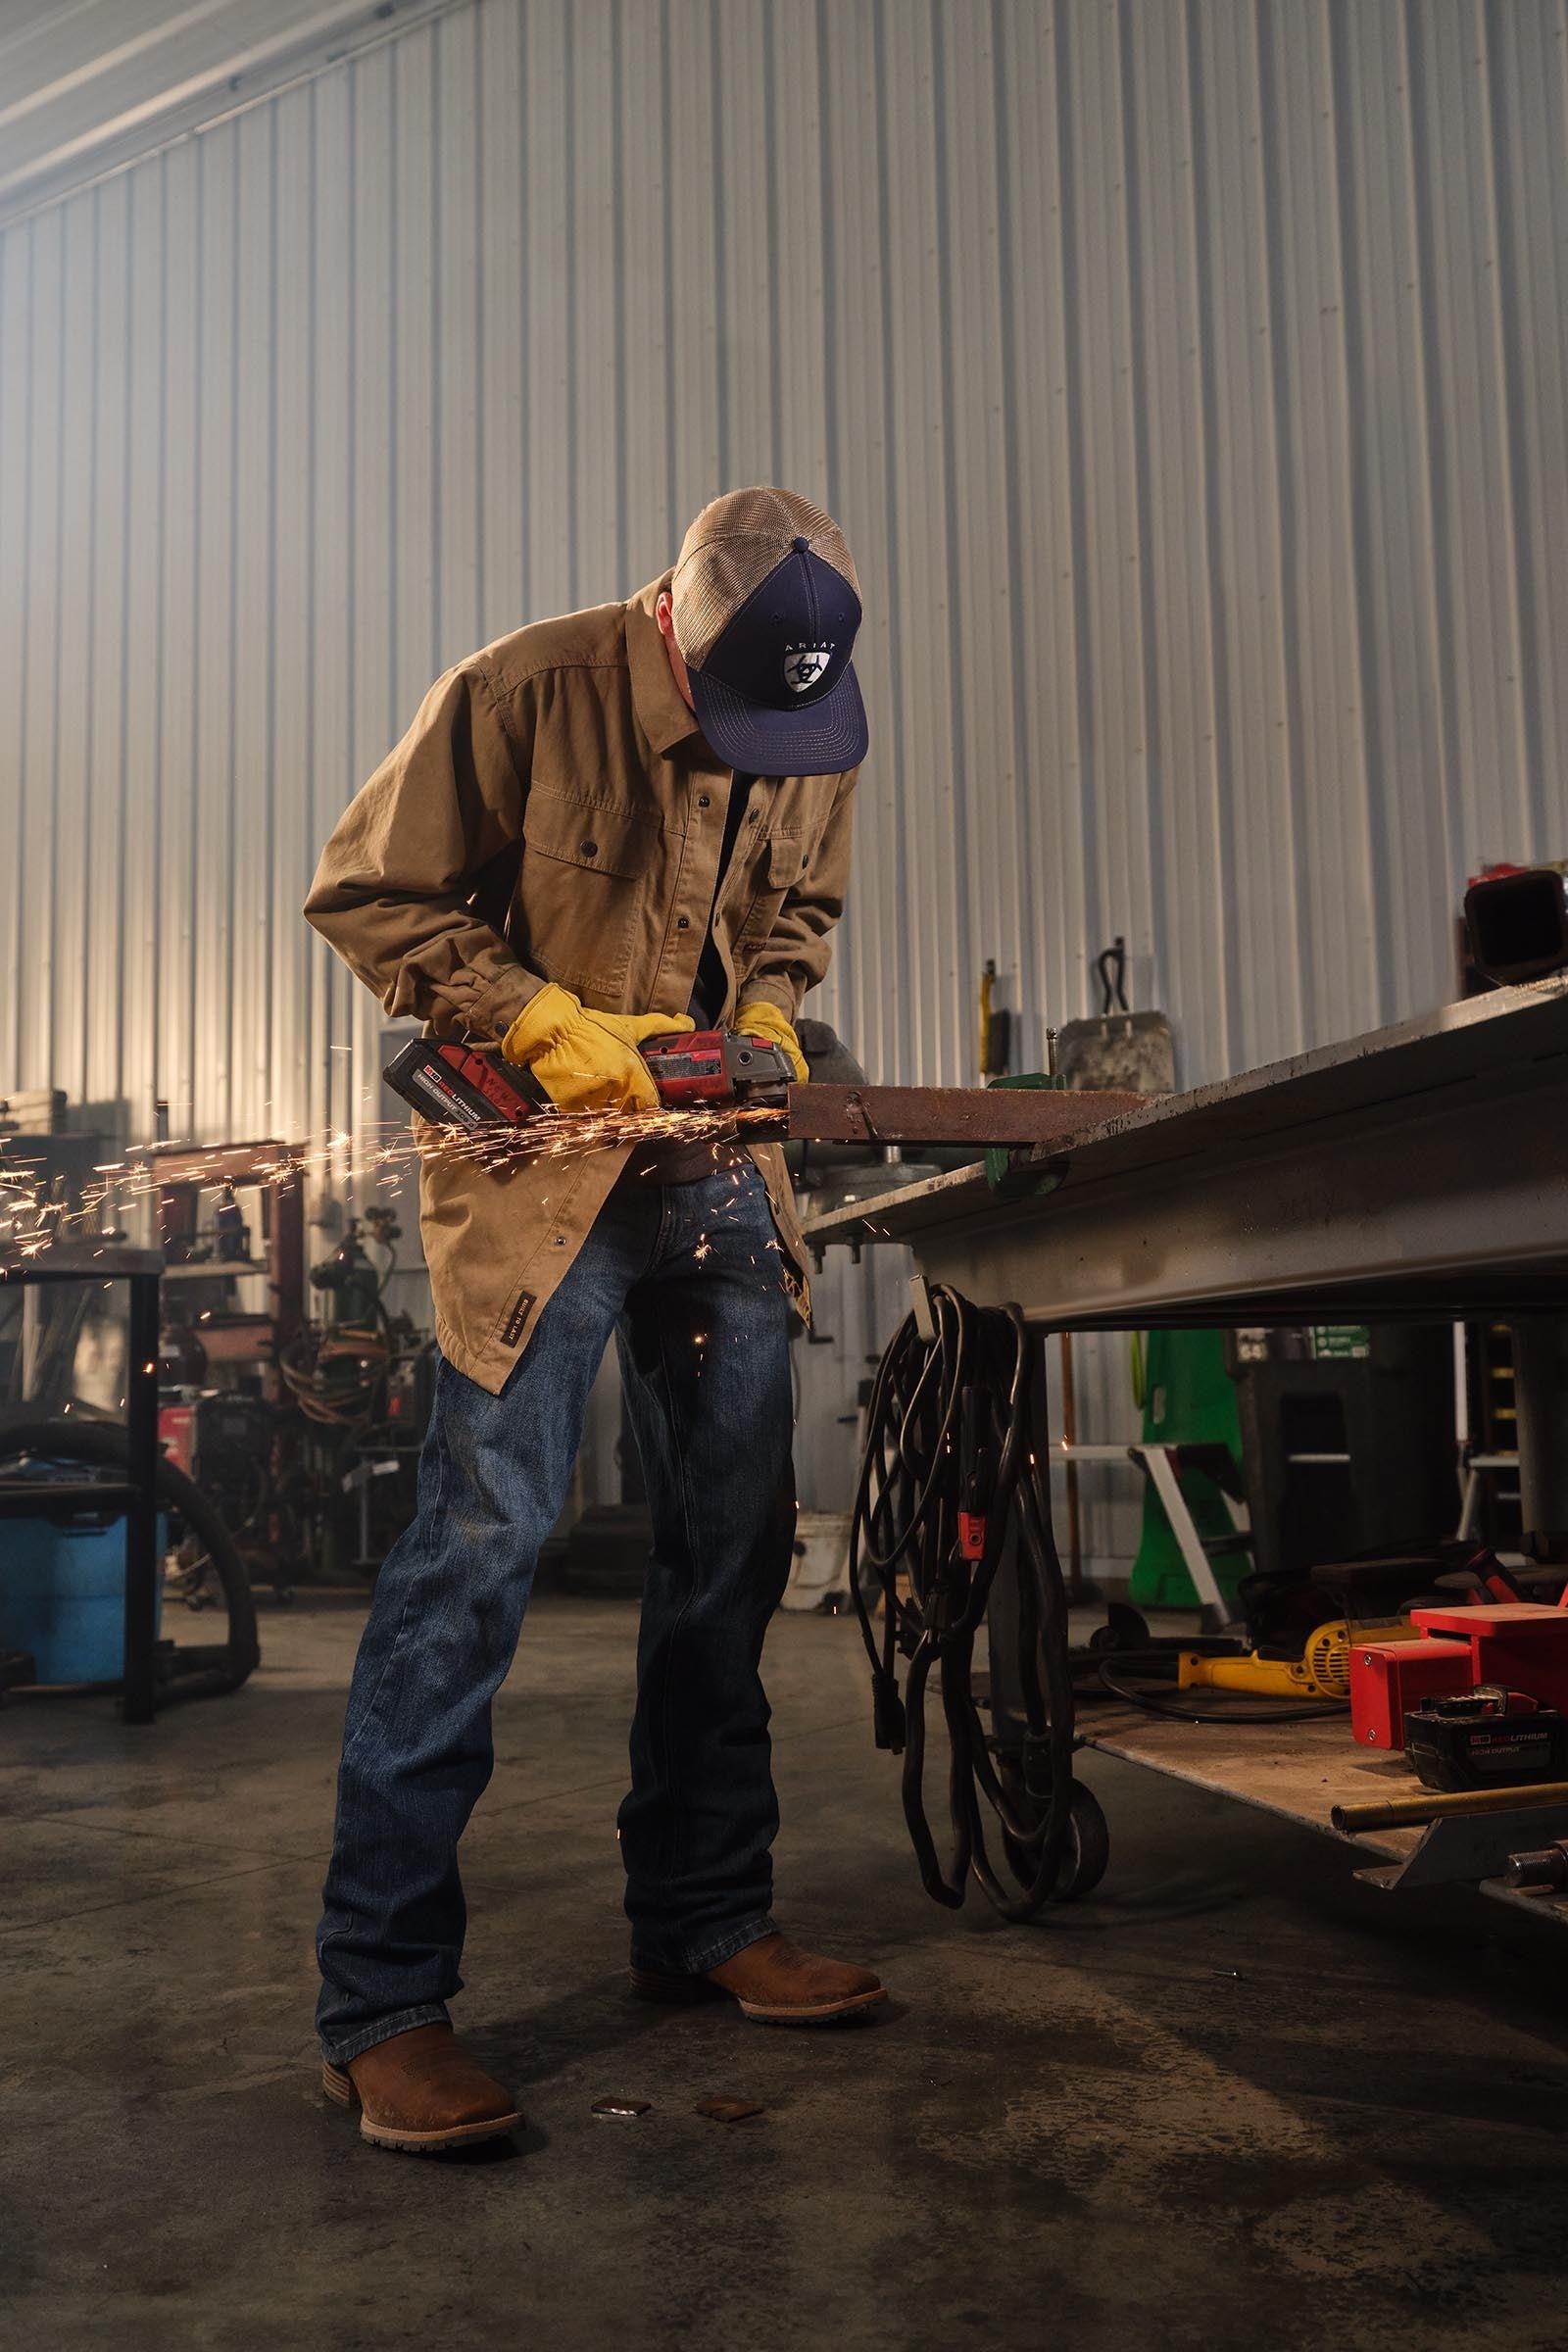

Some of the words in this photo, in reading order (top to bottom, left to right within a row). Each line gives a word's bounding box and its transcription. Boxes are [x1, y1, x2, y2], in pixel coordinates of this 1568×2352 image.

[785, 642, 835, 652] ARIAT
[417, 1073, 434, 1090] HIGH
[432, 1087, 457, 1110] OUTPUT
[422, 1064, 442, 1084] M18
[438, 1081, 481, 1122] REDLITHIUM
[518, 1298, 529, 1316] BUILT
[509, 1326, 517, 1340] LAST
